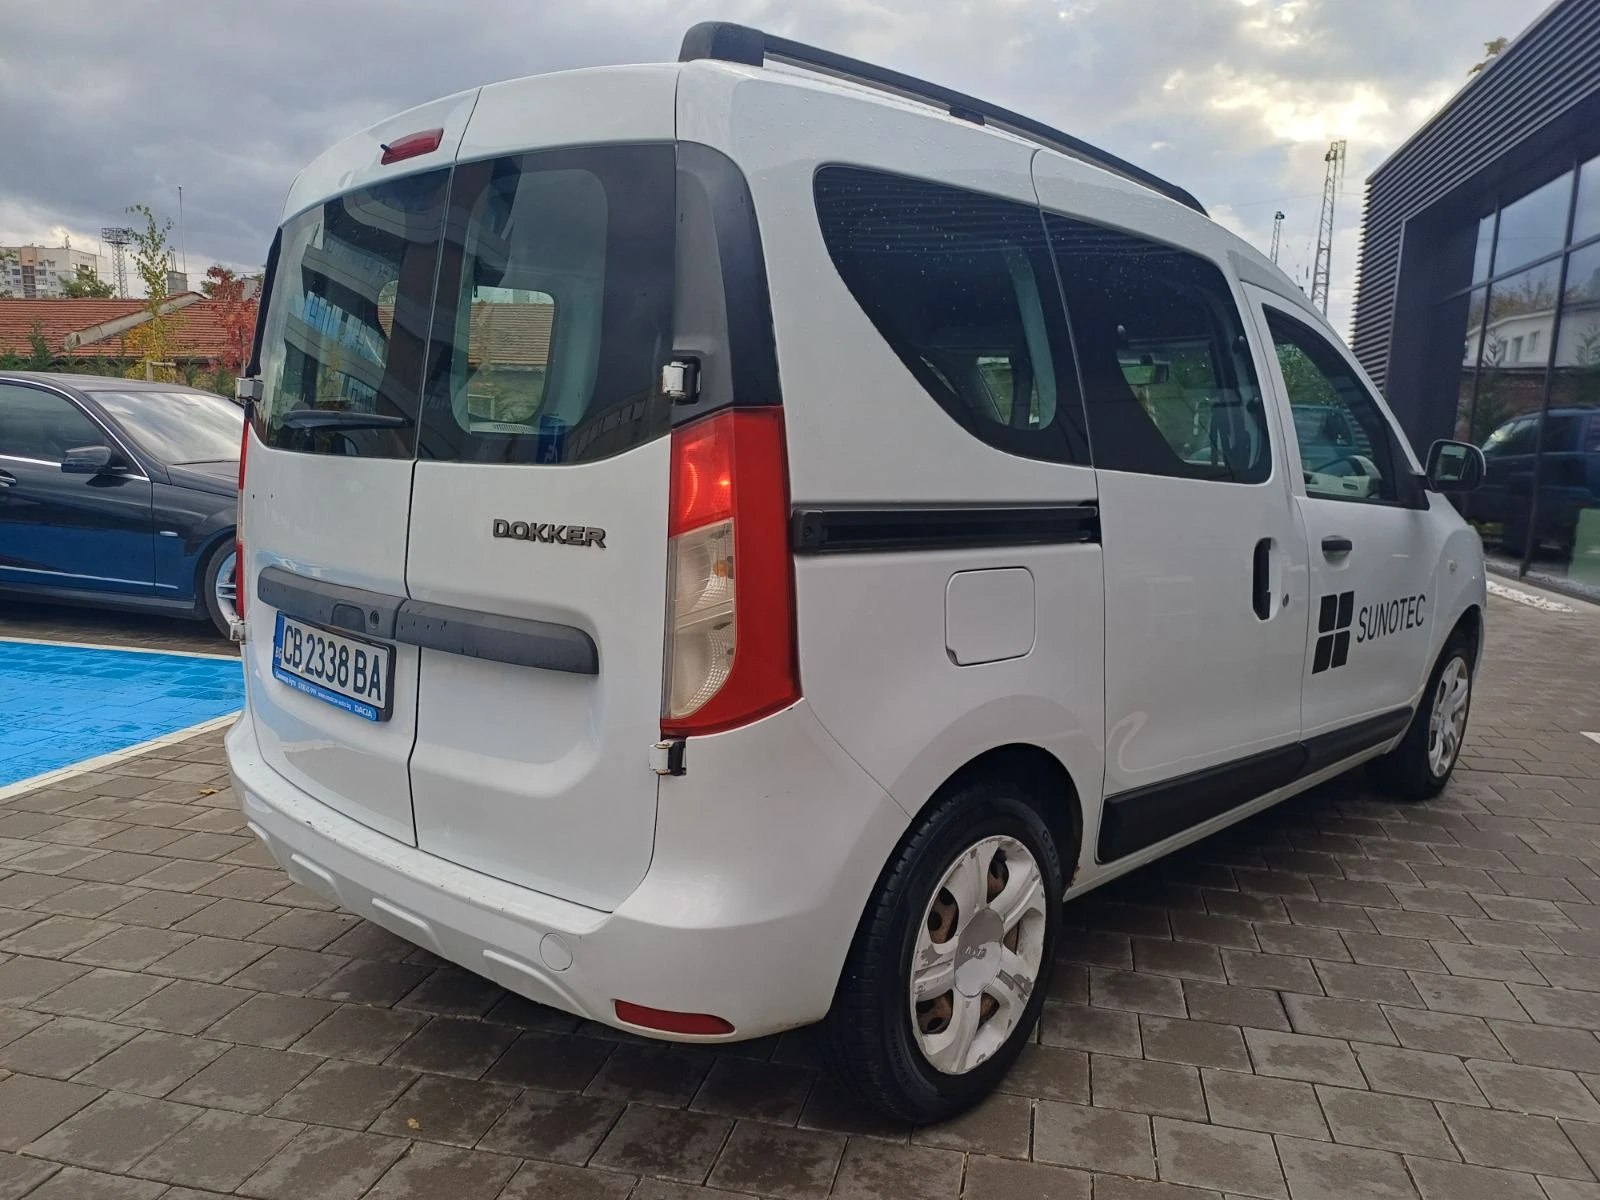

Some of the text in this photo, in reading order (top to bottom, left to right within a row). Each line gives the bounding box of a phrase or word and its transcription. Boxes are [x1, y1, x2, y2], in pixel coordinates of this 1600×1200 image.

[493, 519, 607, 548] DOKKER
[1357, 594, 1426, 643] SUNOTEC
[354, 704, 373, 719] DACIA
